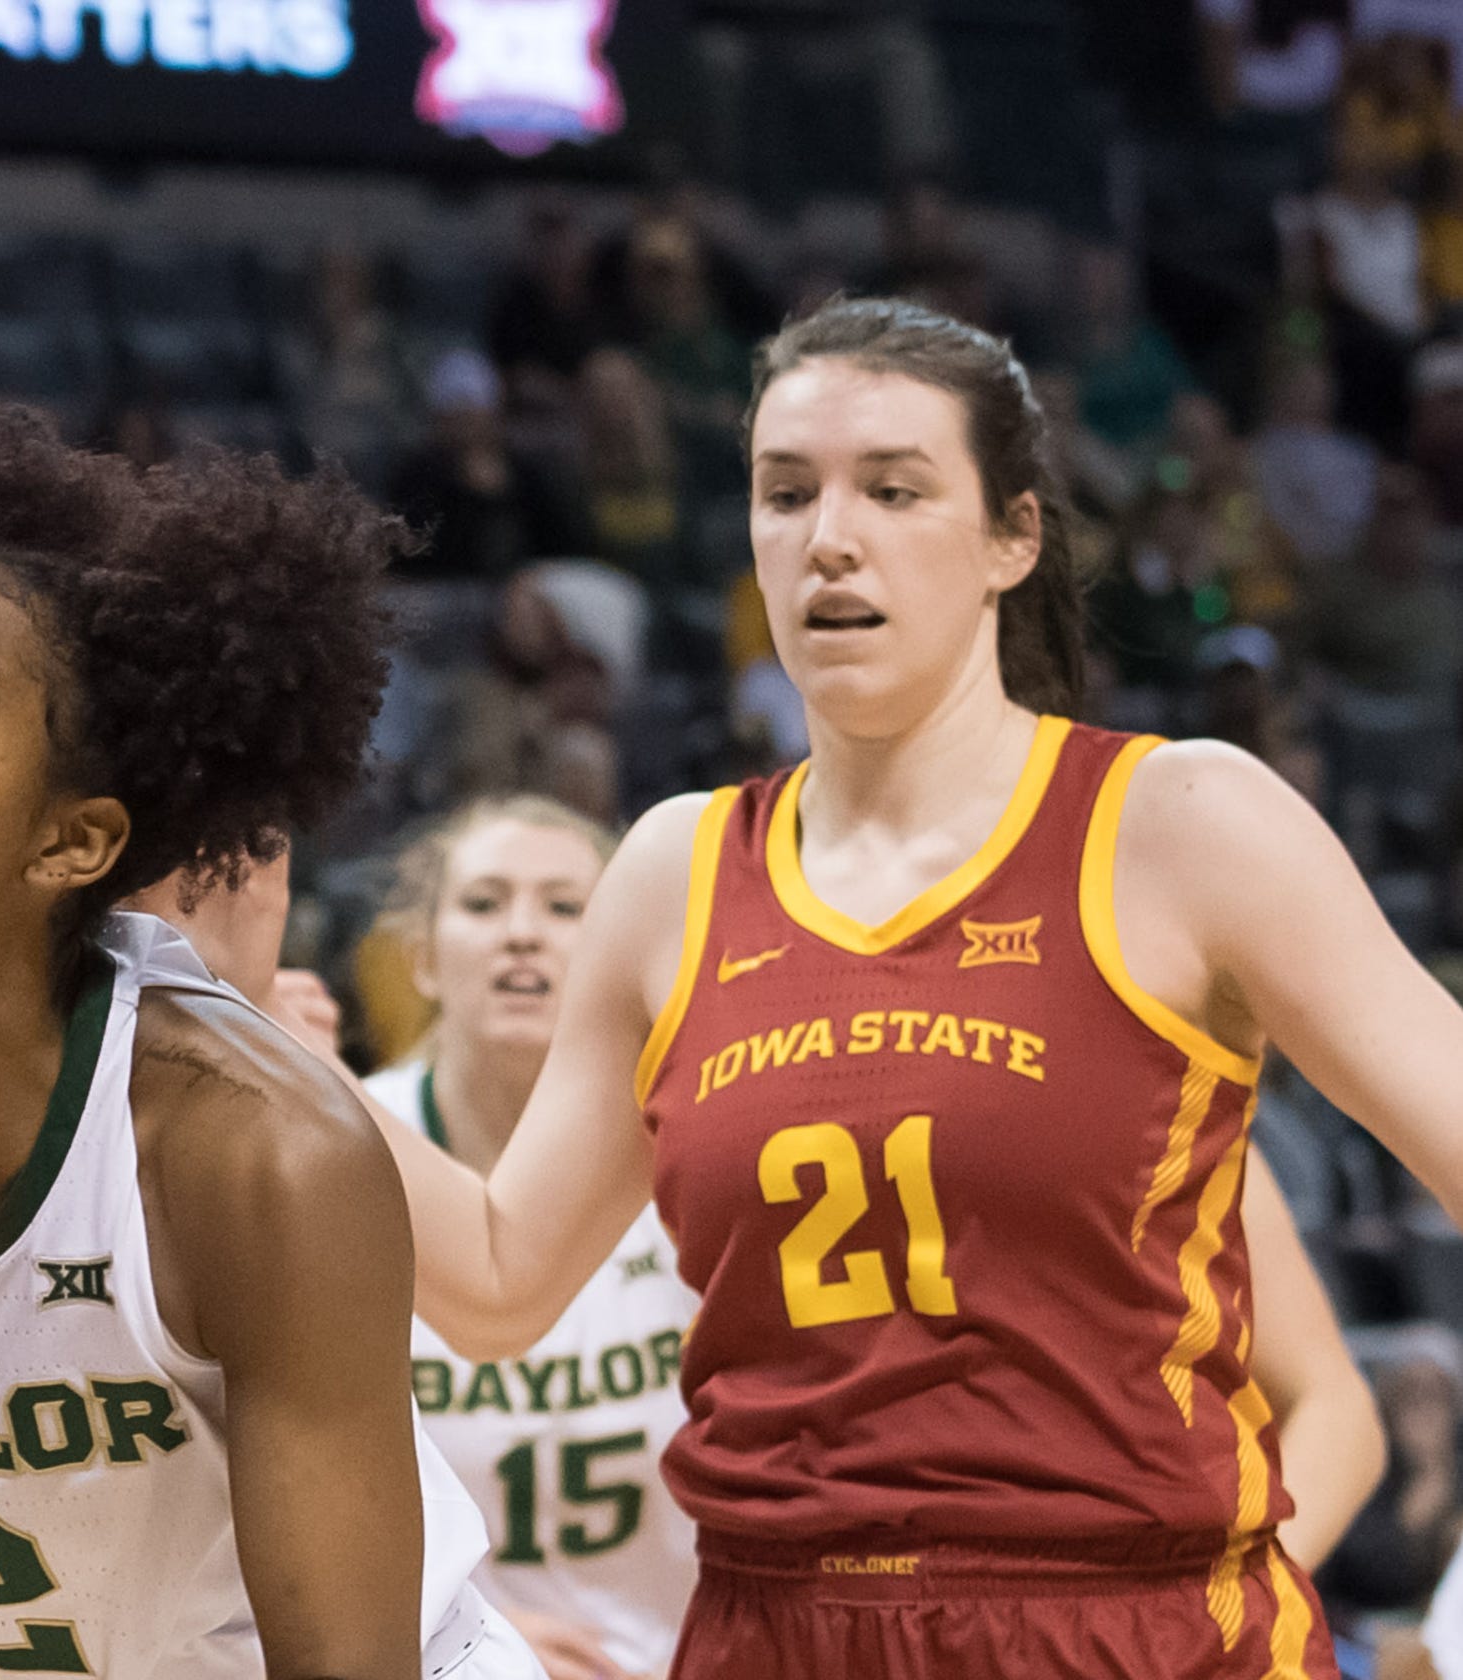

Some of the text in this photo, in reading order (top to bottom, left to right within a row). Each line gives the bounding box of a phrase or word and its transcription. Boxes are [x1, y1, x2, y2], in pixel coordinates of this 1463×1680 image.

[695, 1010, 1046, 1105] IOWA STATE
[757, 1114, 958, 1329] 21
[37, 1258, 116, 1307] XII
[411, 1329, 681, 1414] BAYLOR
[492, 1430, 647, 1567] 15
